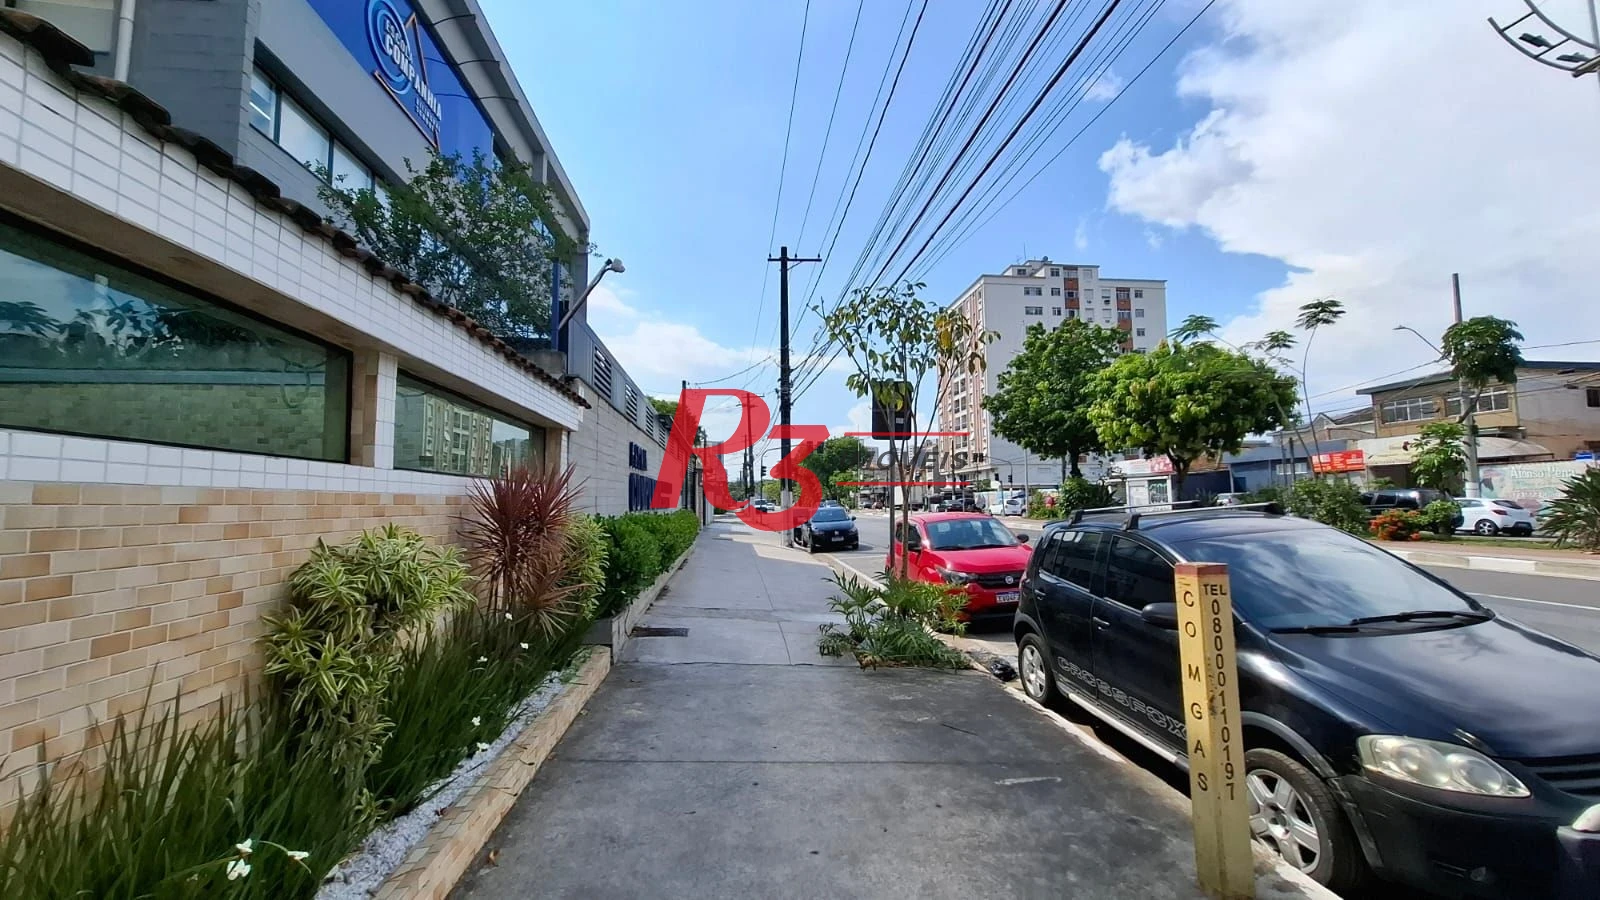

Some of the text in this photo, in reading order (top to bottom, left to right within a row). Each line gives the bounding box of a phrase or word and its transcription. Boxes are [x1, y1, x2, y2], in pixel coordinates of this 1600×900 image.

[385, 34, 441, 121] COMPANHIA
[1203, 584, 1227, 596] TEL
[1057, 656, 1187, 739] CROSSFOX
[1183, 591, 1208, 791] COMGAS
[1212, 599, 1234, 800] 08000110197
